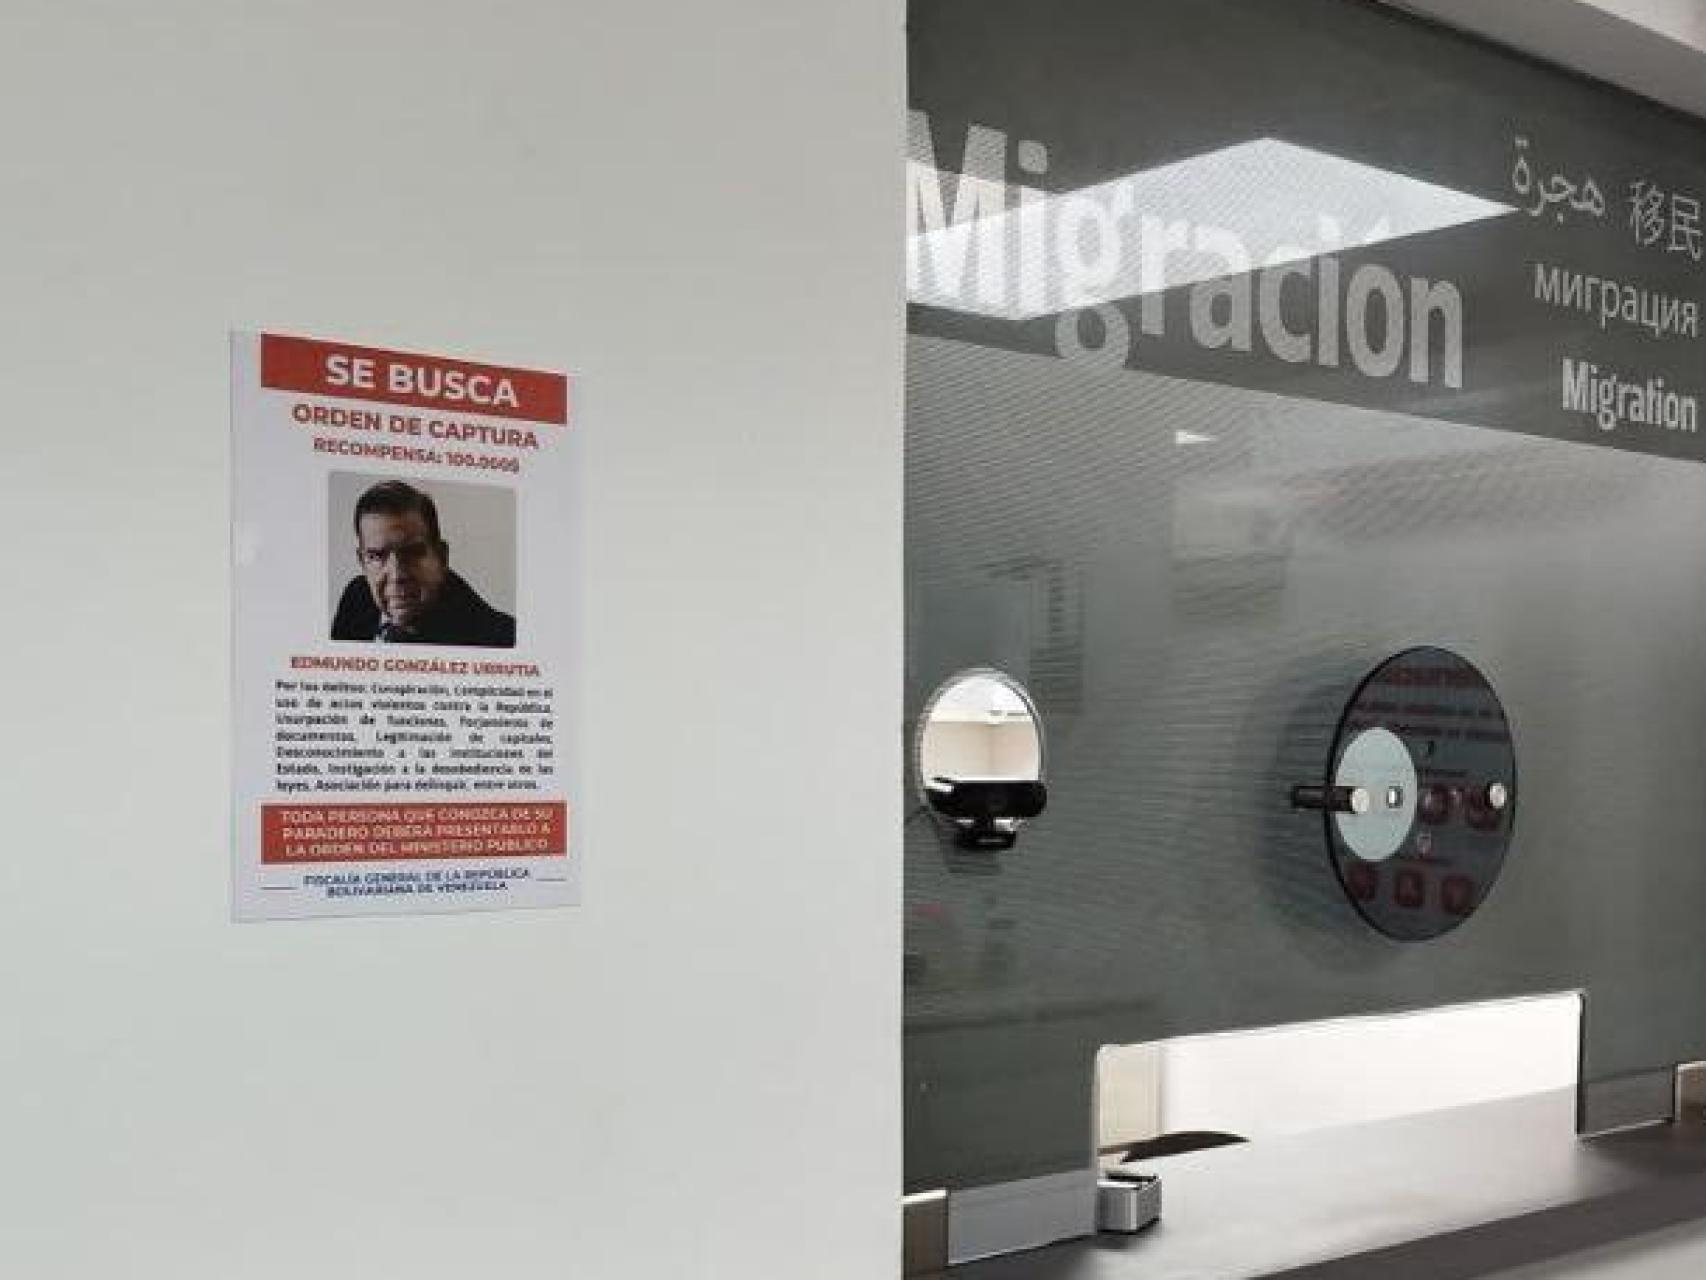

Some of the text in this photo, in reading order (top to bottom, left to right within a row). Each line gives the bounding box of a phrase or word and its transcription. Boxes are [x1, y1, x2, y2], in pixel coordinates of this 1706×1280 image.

[1512, 136, 1605, 224] هجرة
[1631, 180, 1702, 262] 移民
[907, 108, 1462, 388] Migración
[1534, 262, 1697, 338] миграция
[325, 353, 519, 408] SE BUSCA
[1562, 356, 1697, 432] Migration
[292, 402, 540, 450] ORDEN DE CAPTURA
[313, 436, 443, 465] RECOMPENSA:
[291, 656, 379, 671] EDMUNDO
[473, 662, 540, 676] URRUTIA
[276, 680, 297, 692] Por
[300, 681, 319, 692] los
[527, 687, 541, 697] en
[276, 698, 298, 708] uso
[306, 697, 322, 708] de
[330, 698, 362, 709] actos
[371, 698, 425, 710] violentos
[432, 700, 471, 711] contra
[479, 700, 489, 712] la
[276, 714, 348, 727] Usurpación
[359, 714, 376, 725] de
[540, 717, 553, 729] de
[375, 730, 452, 744] Legitimación
[469, 732, 483, 743] de
[276, 747, 384, 758] Desconocimiento
[418, 748, 435, 758] las
[449, 748, 523, 758] instituciones
[536, 748, 553, 759] del
[328, 763, 395, 777] Instigación
[415, 763, 425, 774] la
[431, 763, 513, 775] desobediencia
[518, 763, 532, 775] de
[538, 763, 553, 775] las
[315, 779, 381, 791] Asociación
[384, 782, 411, 793] para
[473, 780, 505, 791] entre
[281, 807, 553, 823] TODA PERSONA QUE CONOZCA DE SU
[282, 825, 369, 841] PARADERO
[437, 821, 538, 838] PRESENTARLO
[541, 821, 552, 836] A
[285, 843, 306, 857] LA
[309, 842, 365, 856] ORDEN
[369, 841, 396, 855] DEL
[400, 838, 484, 854] MINISTERIO
[364, 871, 421, 885] GENERAL
[425, 870, 441, 883] DE
[445, 870, 461, 881] LA
[327, 880, 508, 898] BOLIVARIANA DE VENEZUELA
